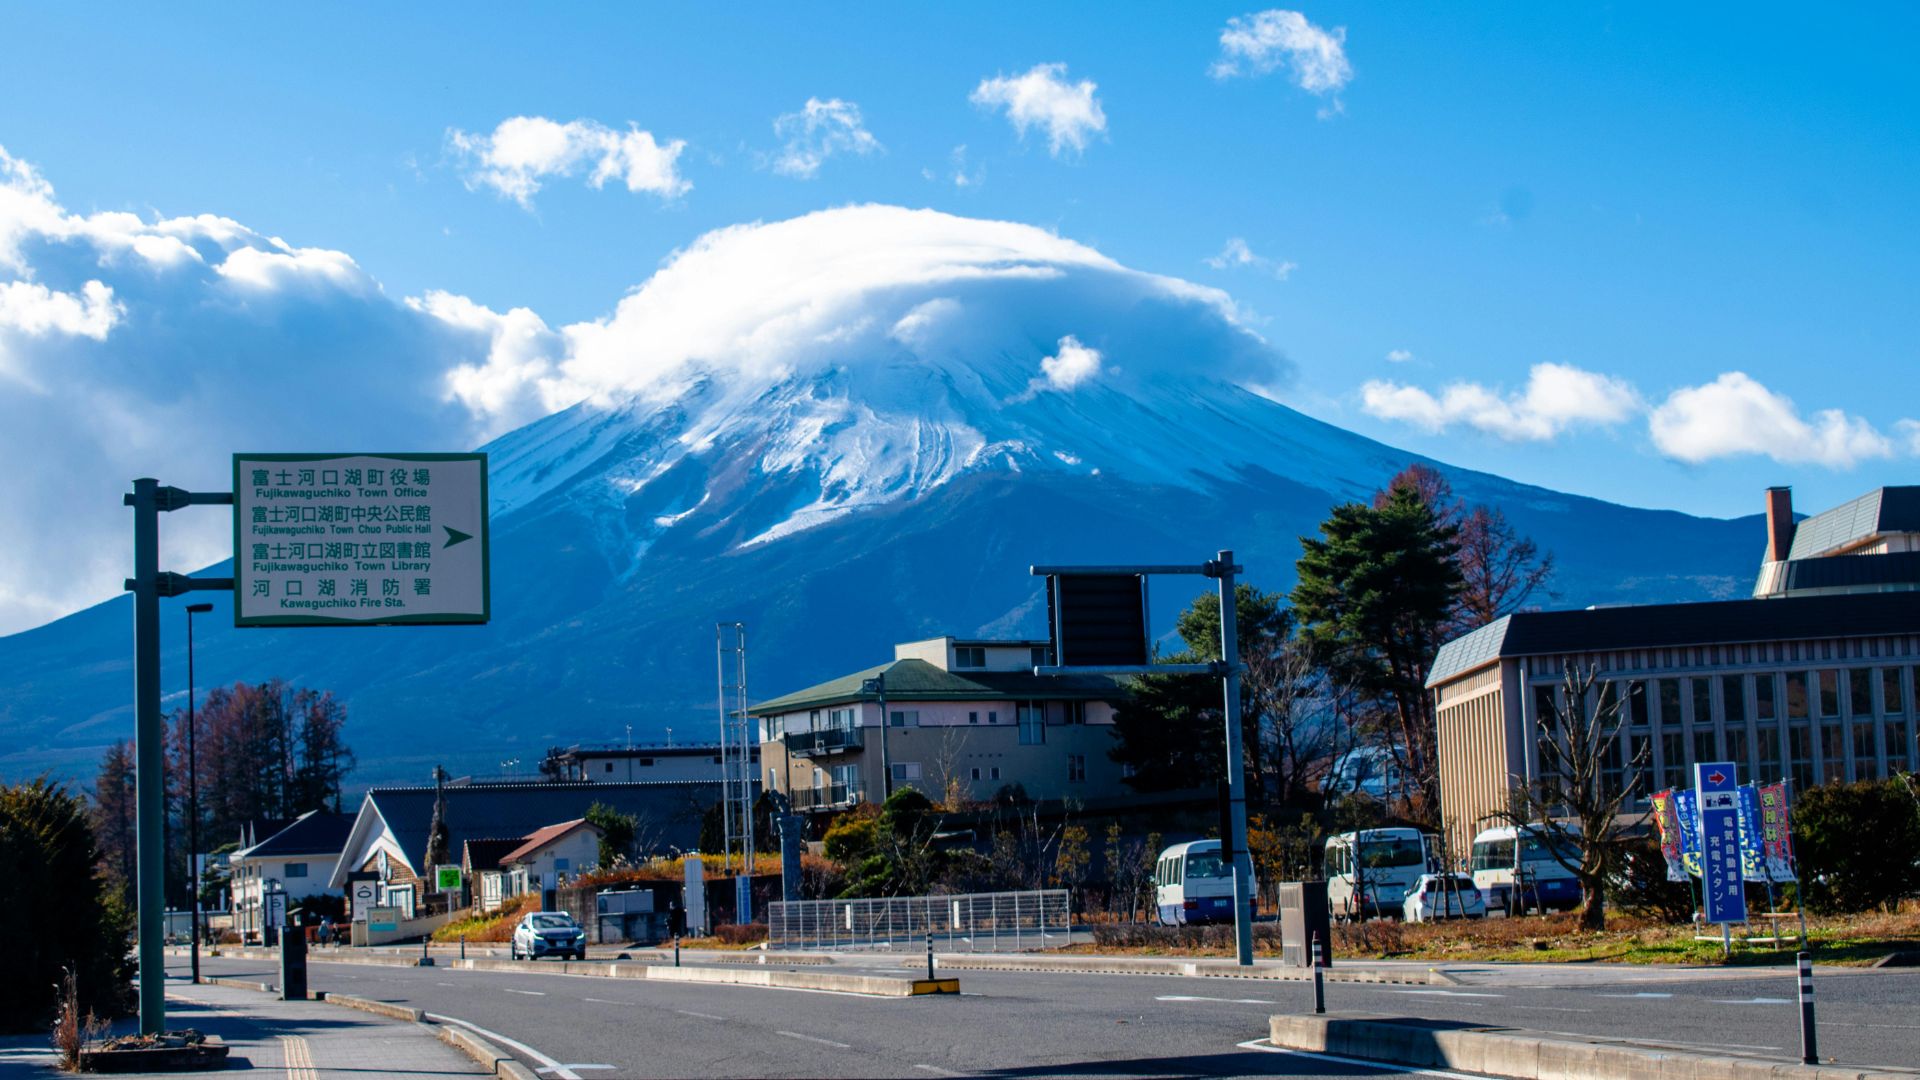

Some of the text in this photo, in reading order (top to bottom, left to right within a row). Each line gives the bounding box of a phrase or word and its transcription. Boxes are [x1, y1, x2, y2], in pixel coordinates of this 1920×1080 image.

[252, 469, 431, 486] 富士河口湖町役場
[256, 488, 427, 500] Fujikawaguchiko Town Office
[252, 505, 431, 523] 富士河口湖町中央公民館
[252, 524, 431, 537] Fujikawaguchiko Town Chuo Public Hall
[252, 542, 431, 560] 富士河口湖町立図書館
[253, 562, 431, 574] Fujikawaguchiko Town Library
[252, 578, 432, 597] 河口湖消防署
[280, 597, 406, 610] Kawaguchiko Fire Sta.
[1723, 816, 1738, 896] 電気自動車用
[1709, 836, 1724, 915] 充電スタンド
